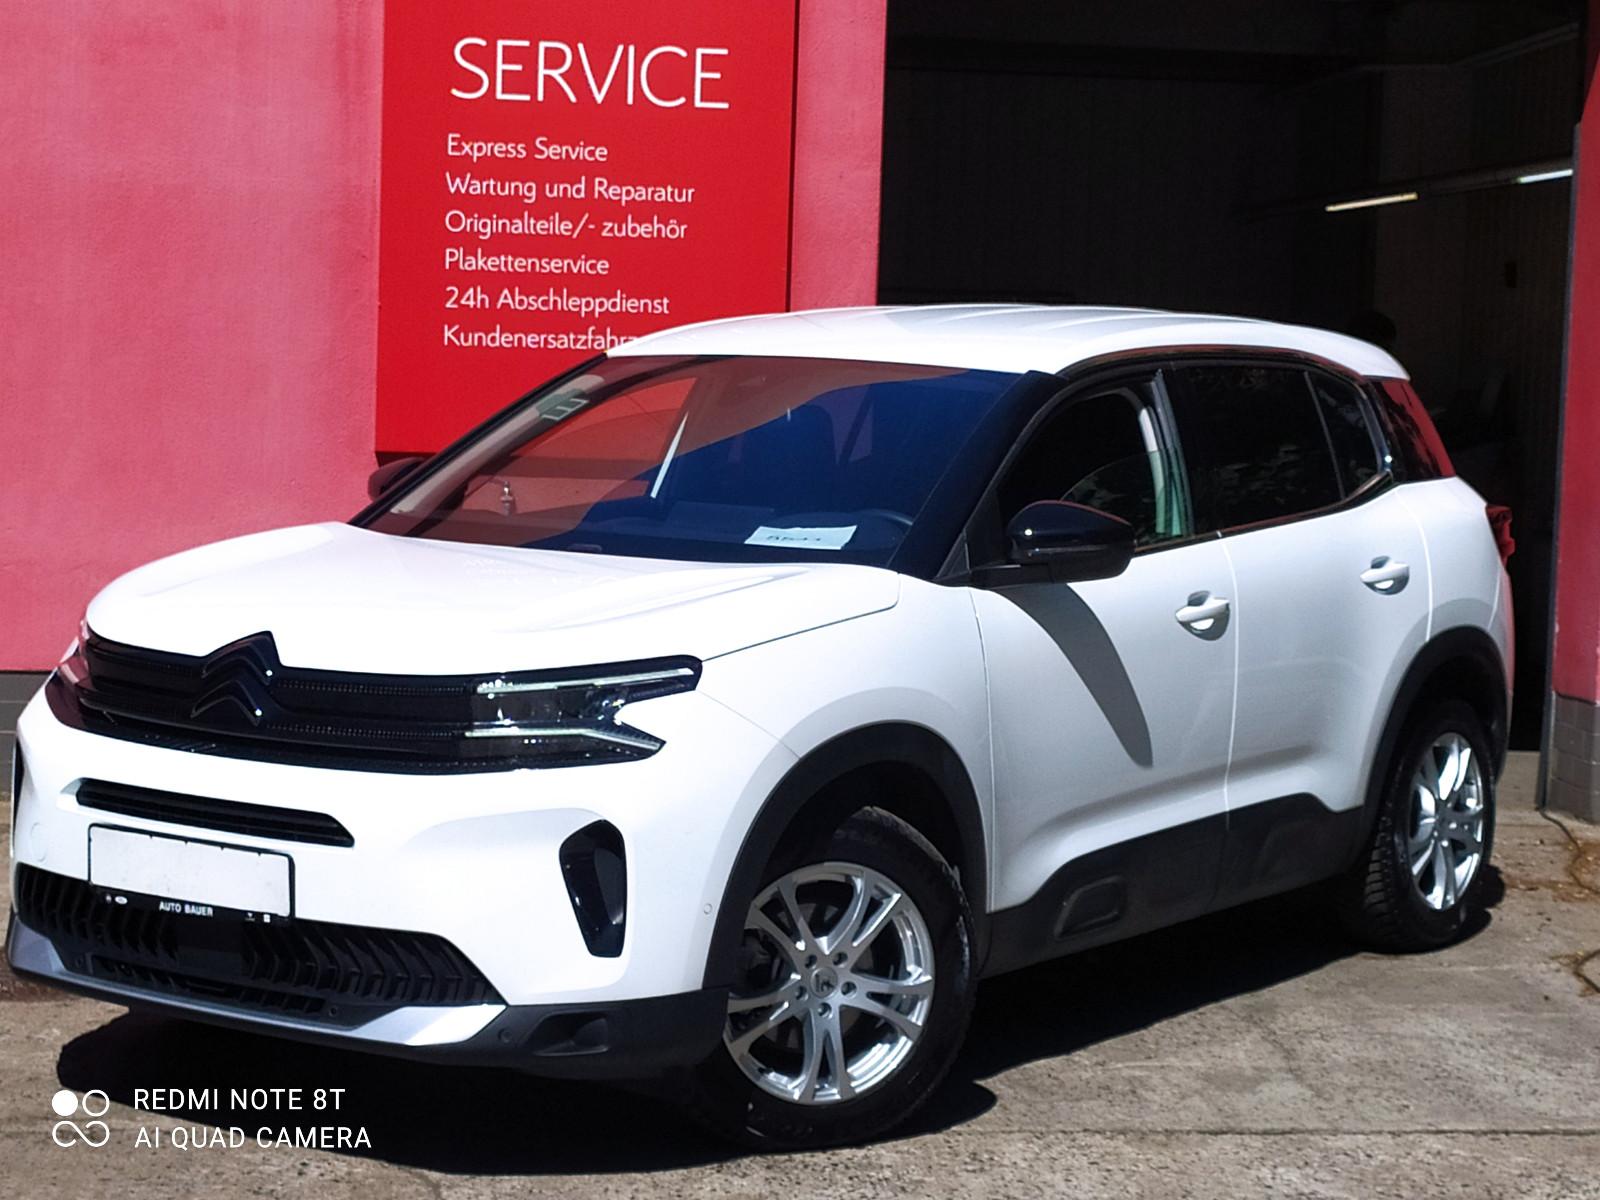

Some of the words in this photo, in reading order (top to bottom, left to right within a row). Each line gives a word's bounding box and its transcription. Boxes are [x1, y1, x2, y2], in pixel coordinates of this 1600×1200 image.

[450, 36, 730, 109] SERVICE
[447, 133, 527, 162] Express
[534, 136, 608, 161] Service
[445, 171, 537, 203] Wartung
[545, 175, 586, 199] und
[594, 177, 695, 206] Reparatur
[601, 214, 688, 239] zubehör
[445, 247, 610, 274] Plakettenservice
[445, 285, 490, 309] 24h
[496, 286, 670, 317] Abschleppdienst
[158, 901, 182, 913] AUTO
[184, 904, 214, 917] BAUER
